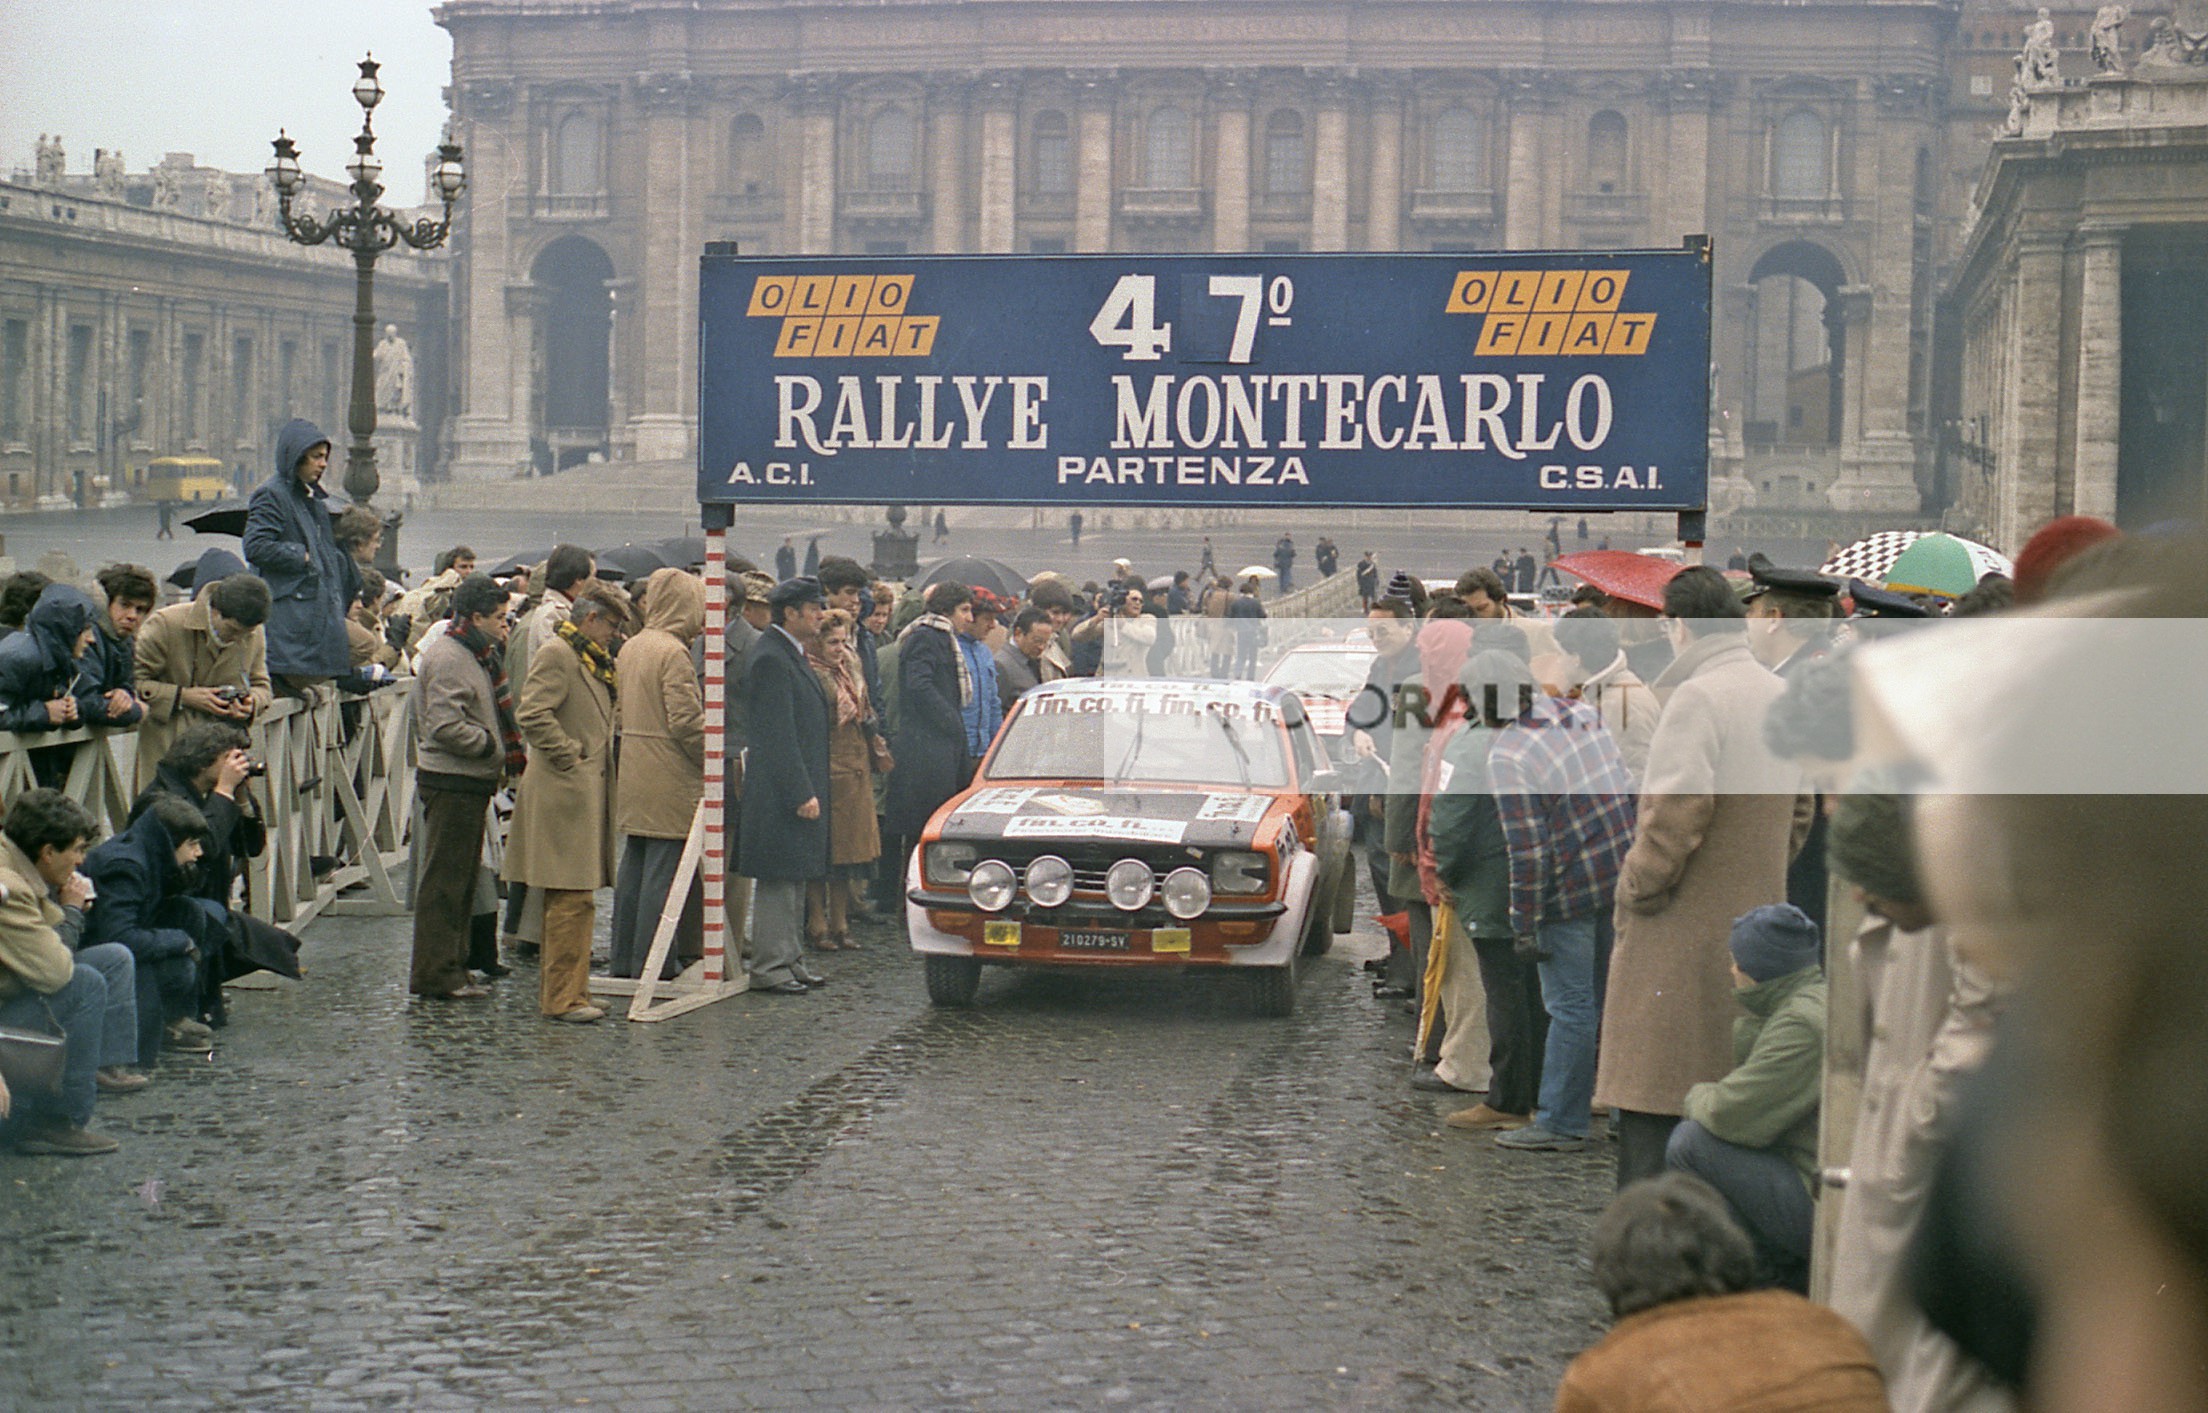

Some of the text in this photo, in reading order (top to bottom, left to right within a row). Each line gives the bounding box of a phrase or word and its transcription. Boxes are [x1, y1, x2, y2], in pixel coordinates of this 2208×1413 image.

[761, 282, 902, 309] OLIO
[1461, 277, 1615, 305] OLIO
[788, 324, 930, 349] FIAT
[1489, 321, 1646, 347] FIAT
[773, 373, 1613, 460] RALLYE MONTECARLO
[728, 462, 815, 485] A.C.I.
[1058, 456, 1310, 485] PARTENZA
[1540, 465, 1663, 490] C.S.A.I.
